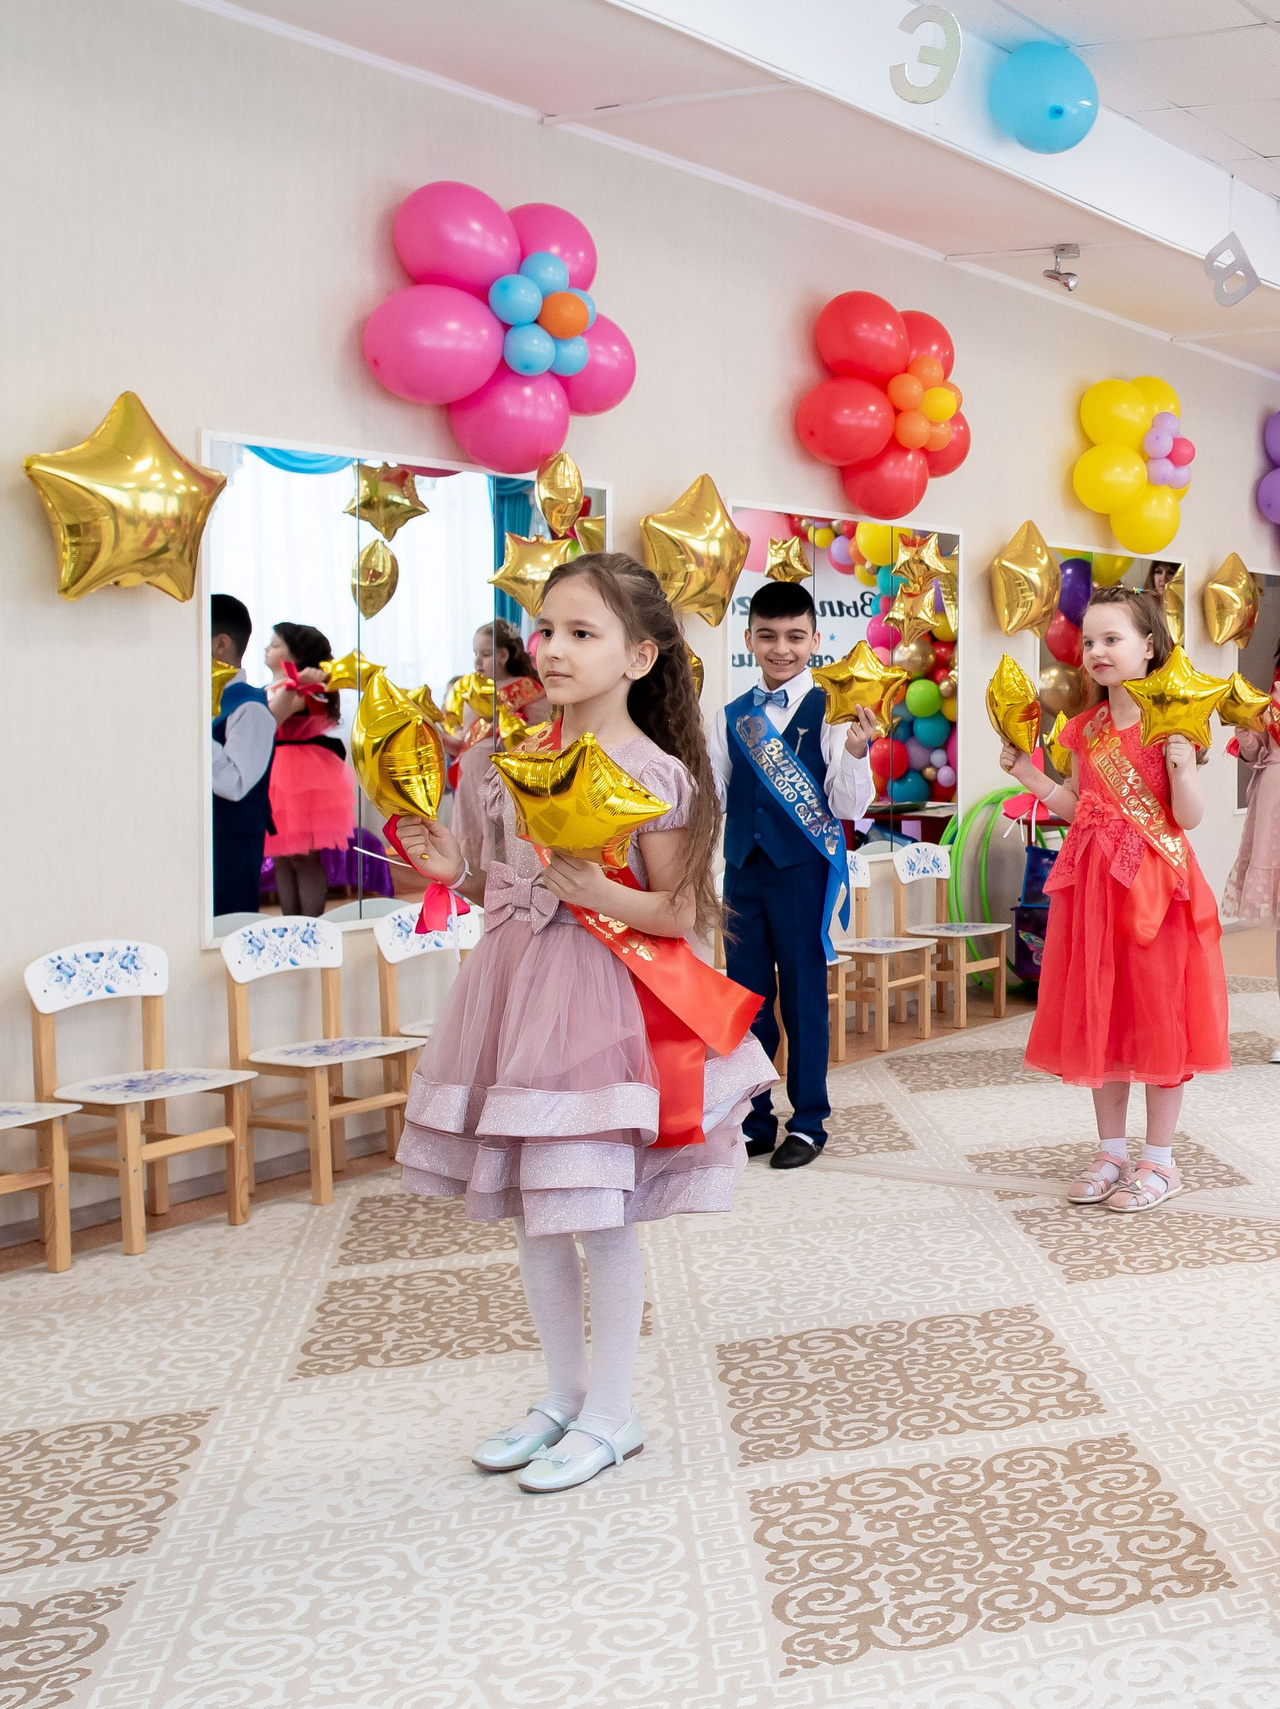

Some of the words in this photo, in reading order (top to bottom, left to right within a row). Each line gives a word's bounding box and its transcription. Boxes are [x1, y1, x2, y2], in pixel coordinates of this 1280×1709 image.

[749, 746, 798, 803] ДЕТСКОГО
[794, 802, 822, 837] САДА
[1093, 748, 1131, 797] ДЕТСКОГО
[1125, 795, 1151, 826] САДА
